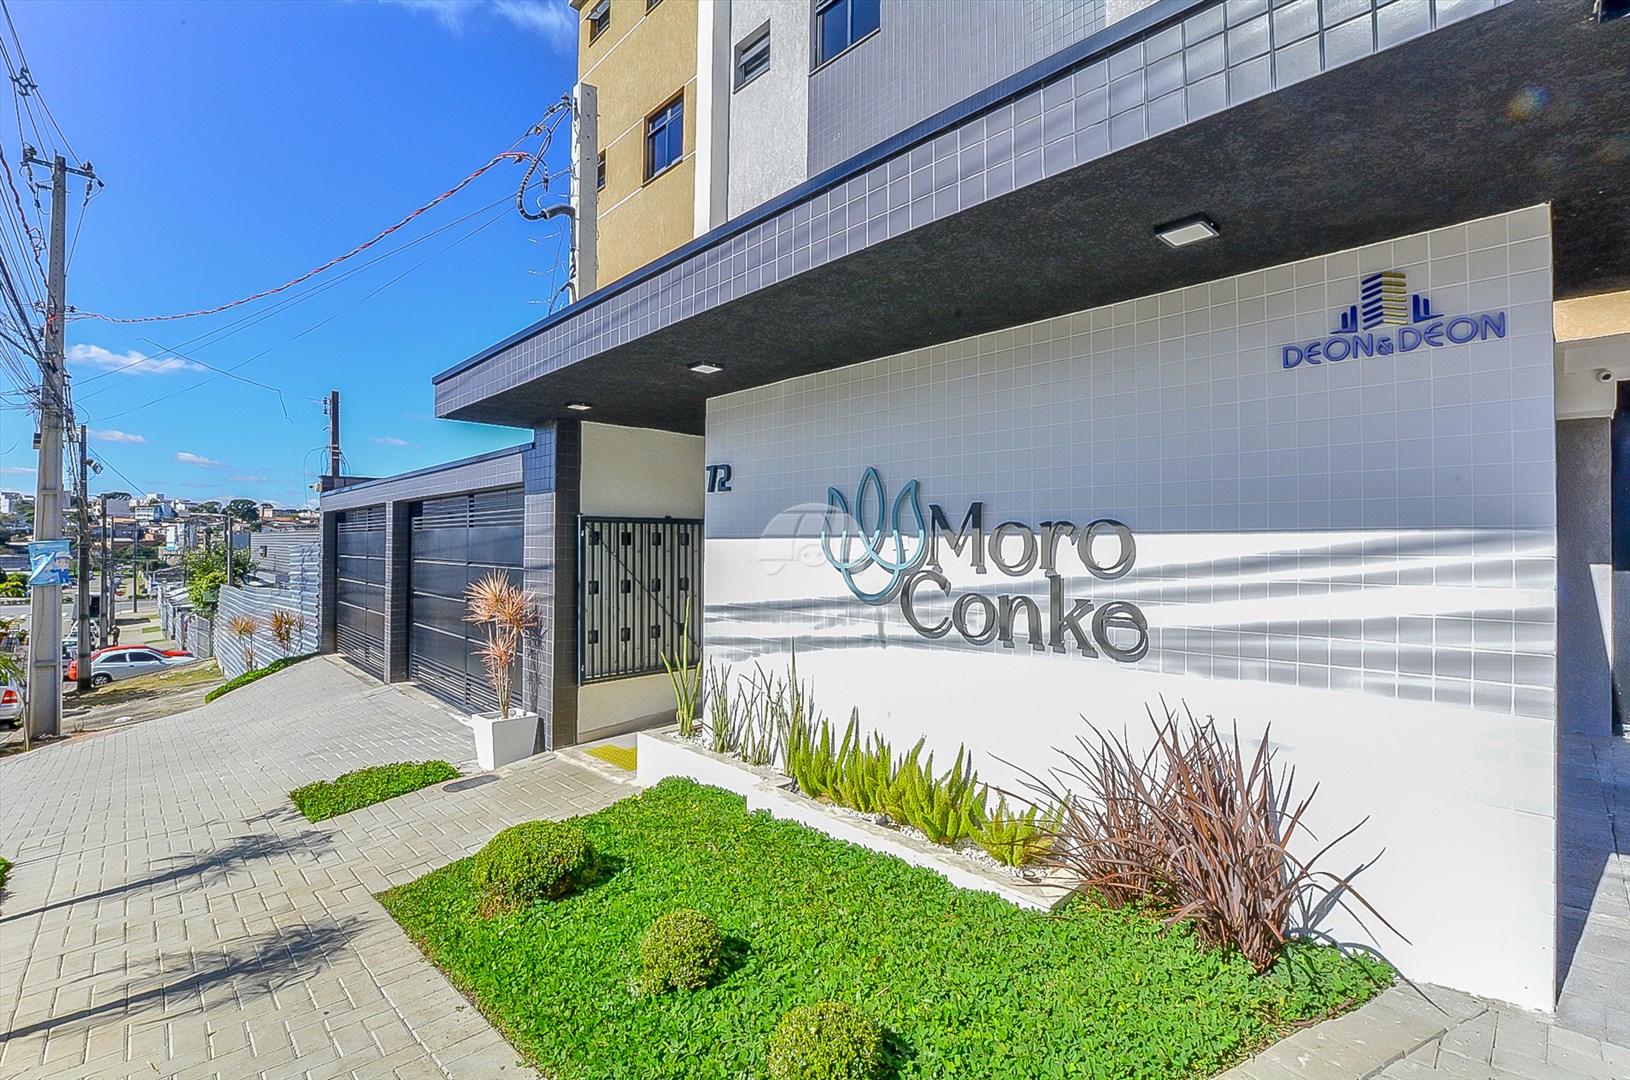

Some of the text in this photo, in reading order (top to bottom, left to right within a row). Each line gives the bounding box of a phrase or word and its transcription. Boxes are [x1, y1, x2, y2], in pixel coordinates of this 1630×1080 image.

[705, 464, 732, 493] 72
[927, 501, 1136, 580] Moro
[900, 570, 1149, 663] Conke
